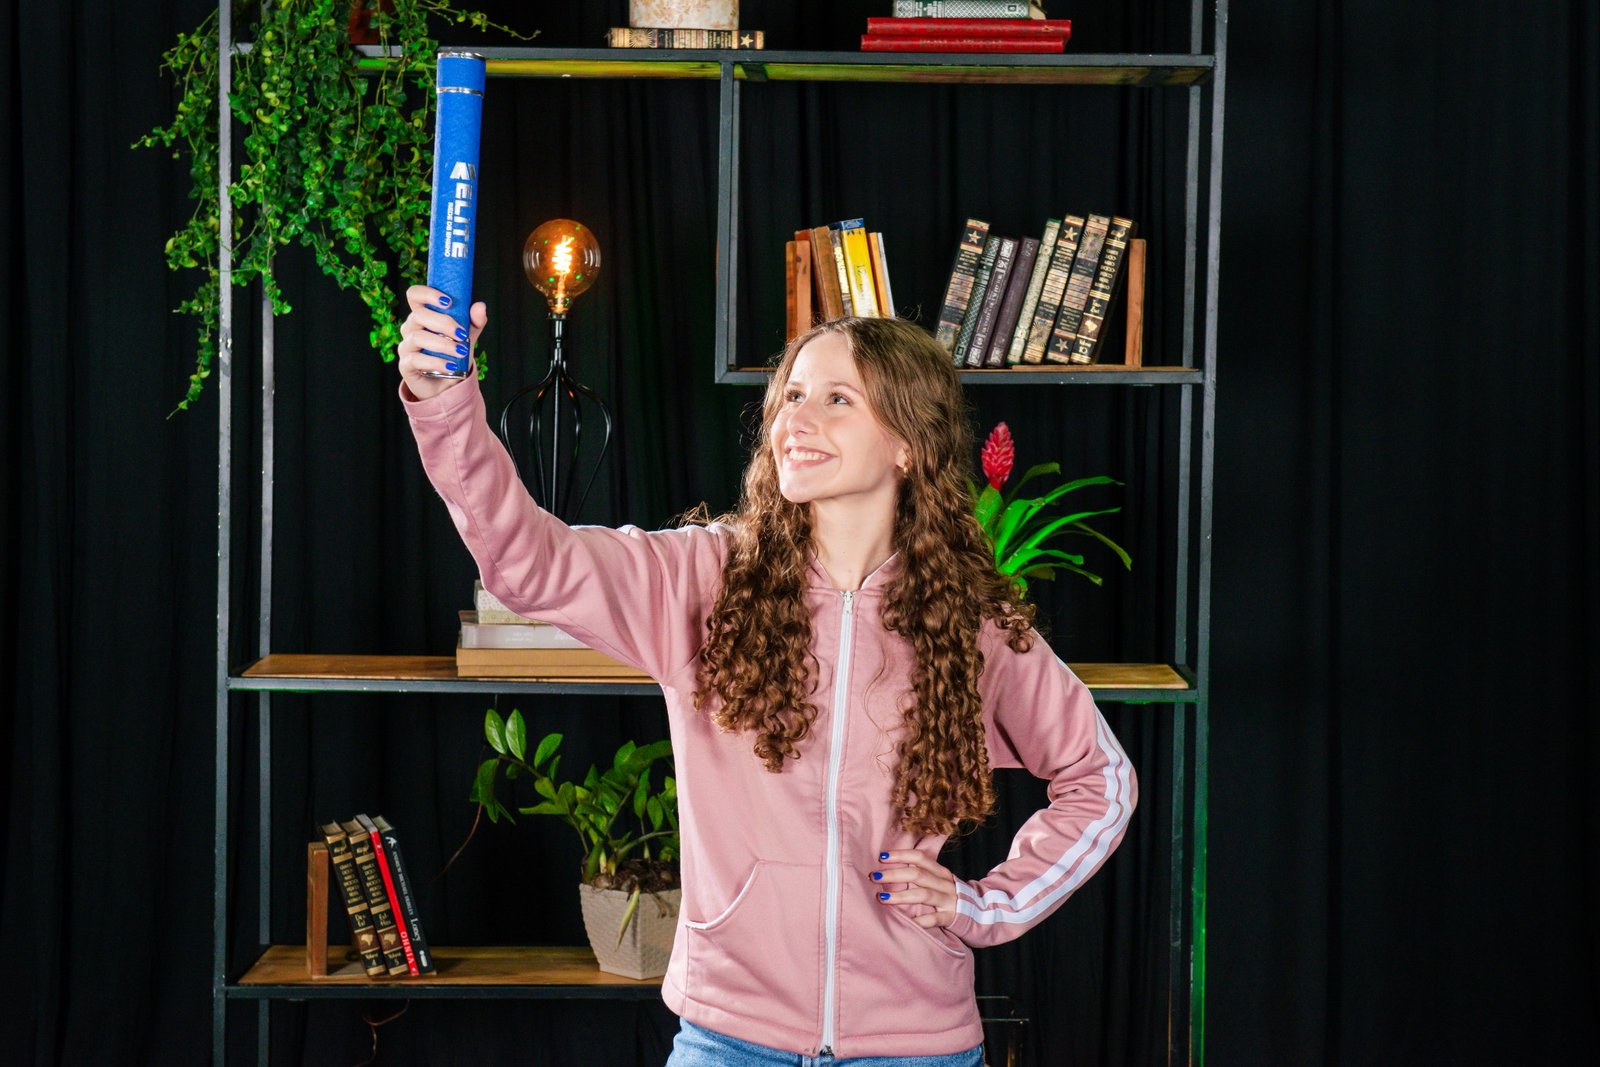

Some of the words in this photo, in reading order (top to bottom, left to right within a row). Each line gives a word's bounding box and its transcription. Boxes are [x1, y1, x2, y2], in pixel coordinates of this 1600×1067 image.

[446, 221, 452, 230] DE
[451, 182, 472, 258] ELITE
[401, 931, 413, 965] VINHO
